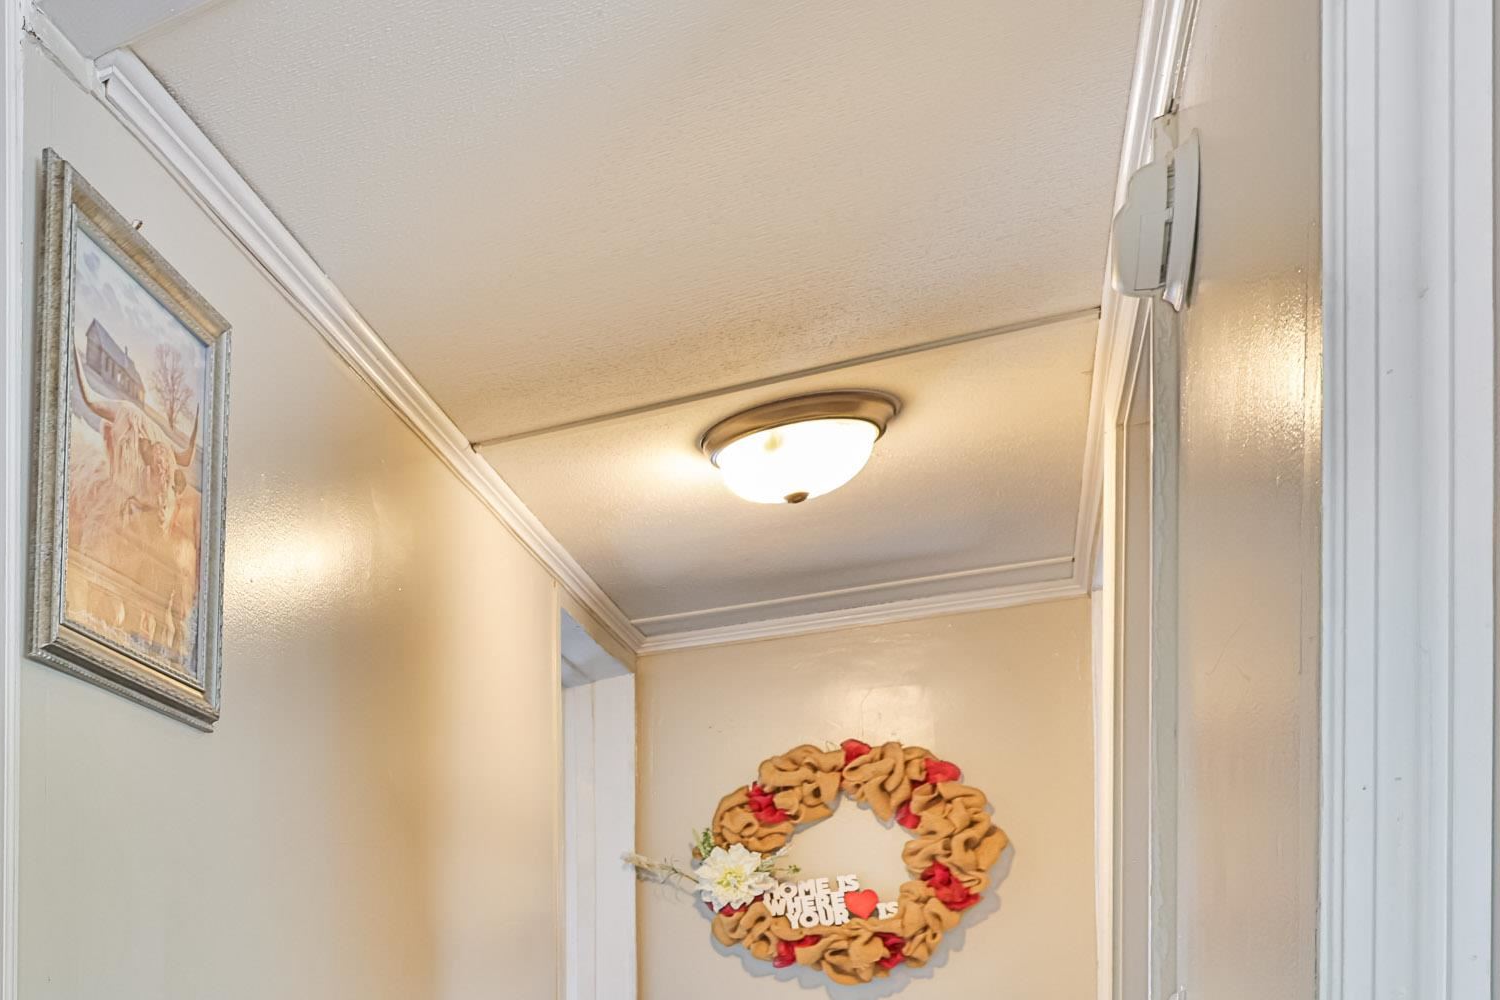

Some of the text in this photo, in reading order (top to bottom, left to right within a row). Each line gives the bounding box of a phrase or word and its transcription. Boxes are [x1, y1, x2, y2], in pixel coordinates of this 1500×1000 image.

[837, 874, 860, 893] IS
[763, 891, 846, 917] WHERE
[786, 901, 899, 929] YOUR IS
